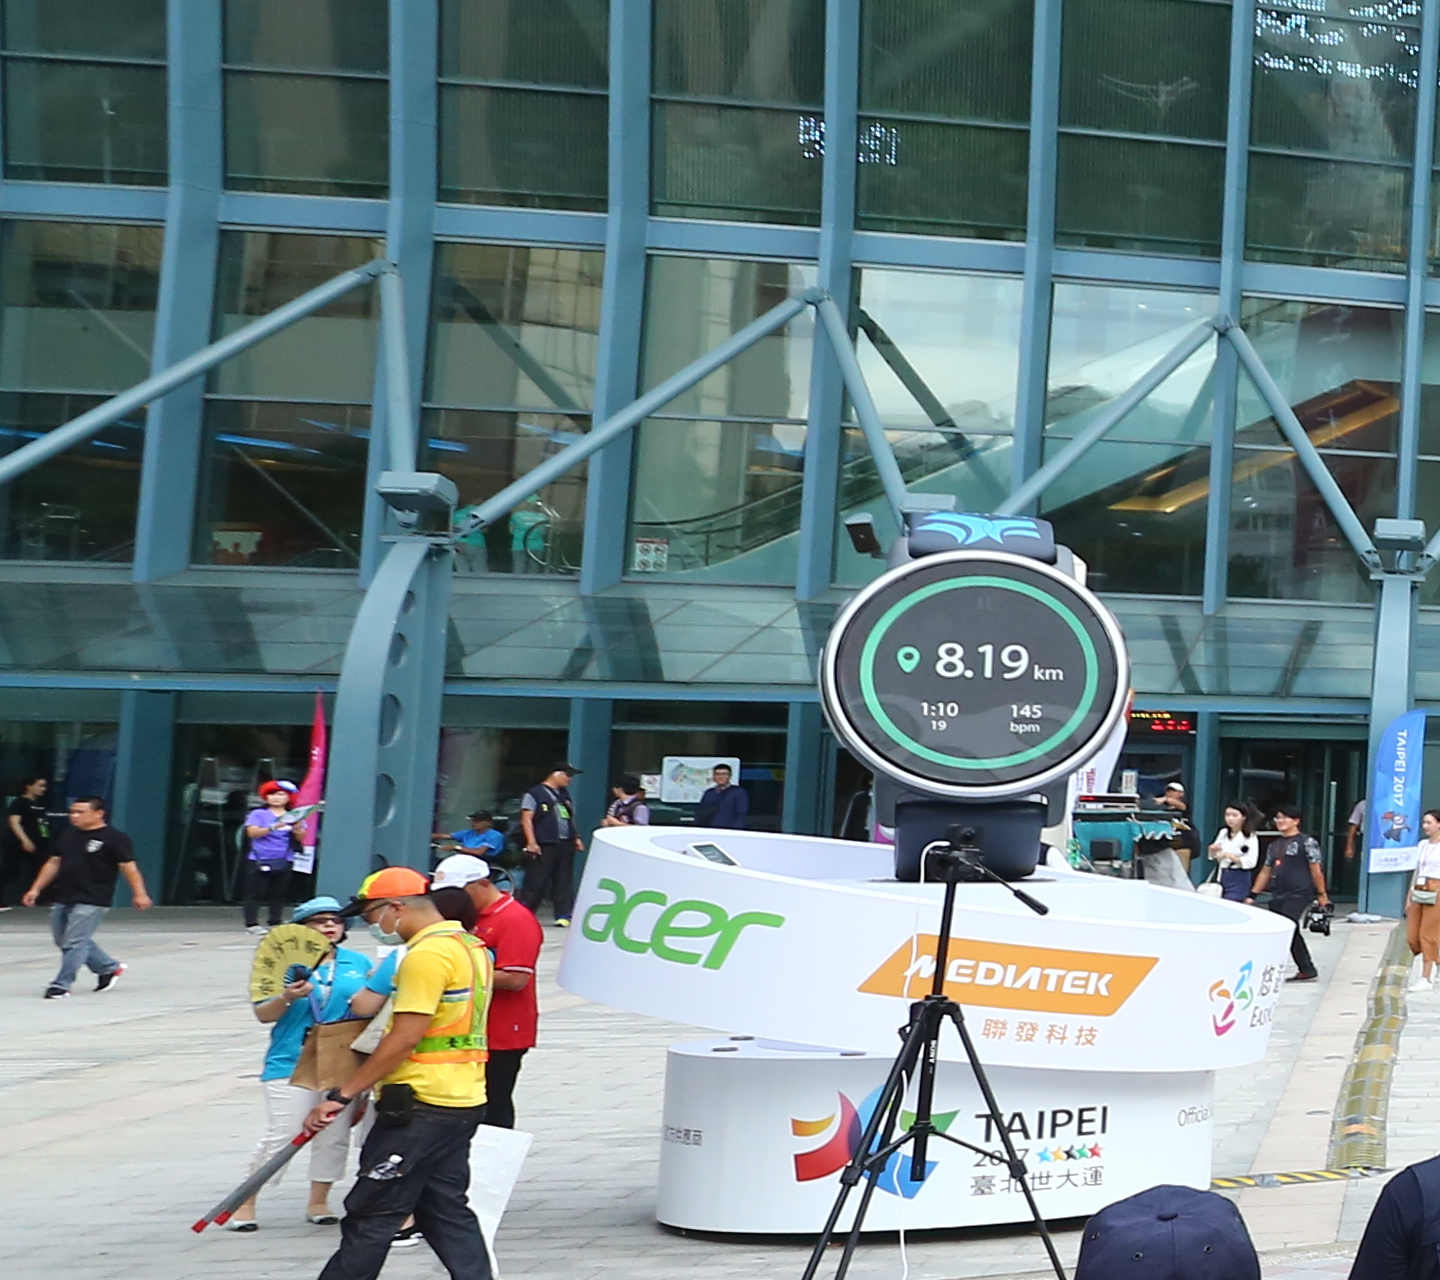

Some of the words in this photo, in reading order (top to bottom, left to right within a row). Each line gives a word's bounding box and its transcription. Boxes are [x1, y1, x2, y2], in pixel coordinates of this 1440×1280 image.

[935, 641, 1030, 679] 8.19
[1033, 664, 1064, 681] km
[920, 701, 959, 717] 1:10
[1010, 704, 1042, 719] 145
[931, 720, 947, 732] 19
[1009, 722, 1040, 734] bpm
[1394, 729, 1407, 772] TAIPEI
[1393, 776, 1405, 807] 2017
[581, 877, 786, 970] acer
[903, 953, 1114, 997] MEDIATEK
[980, 1018, 1099, 1047] 聯發科技
[974, 1105, 1109, 1142] TAIPEI
[970, 1164, 1104, 1197] 臺北世大運
